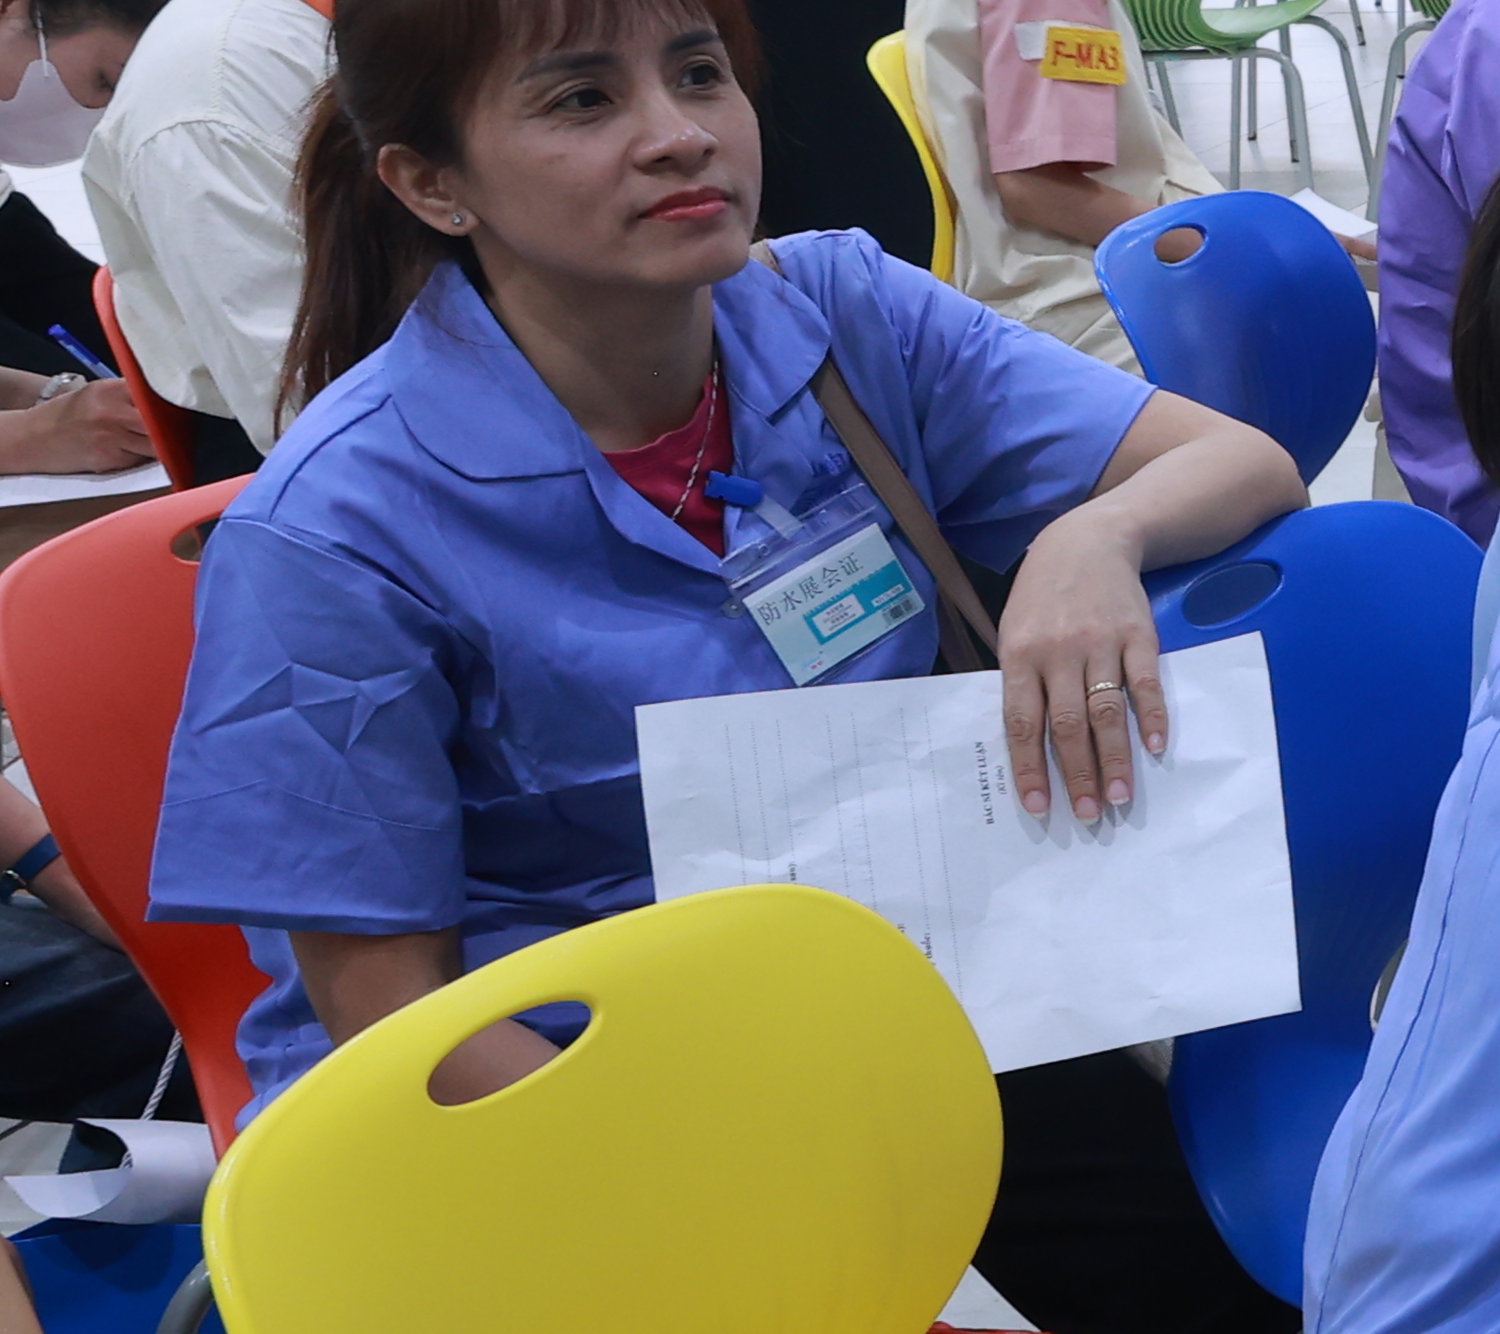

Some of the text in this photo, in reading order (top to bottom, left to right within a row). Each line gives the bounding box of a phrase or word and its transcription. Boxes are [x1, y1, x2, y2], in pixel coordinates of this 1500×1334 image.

[756, 550, 865, 627] 防水展会证
[973, 740, 989, 769] LUẬN
[977, 770, 991, 792] KẾT
[982, 803, 995, 826] BÁC
